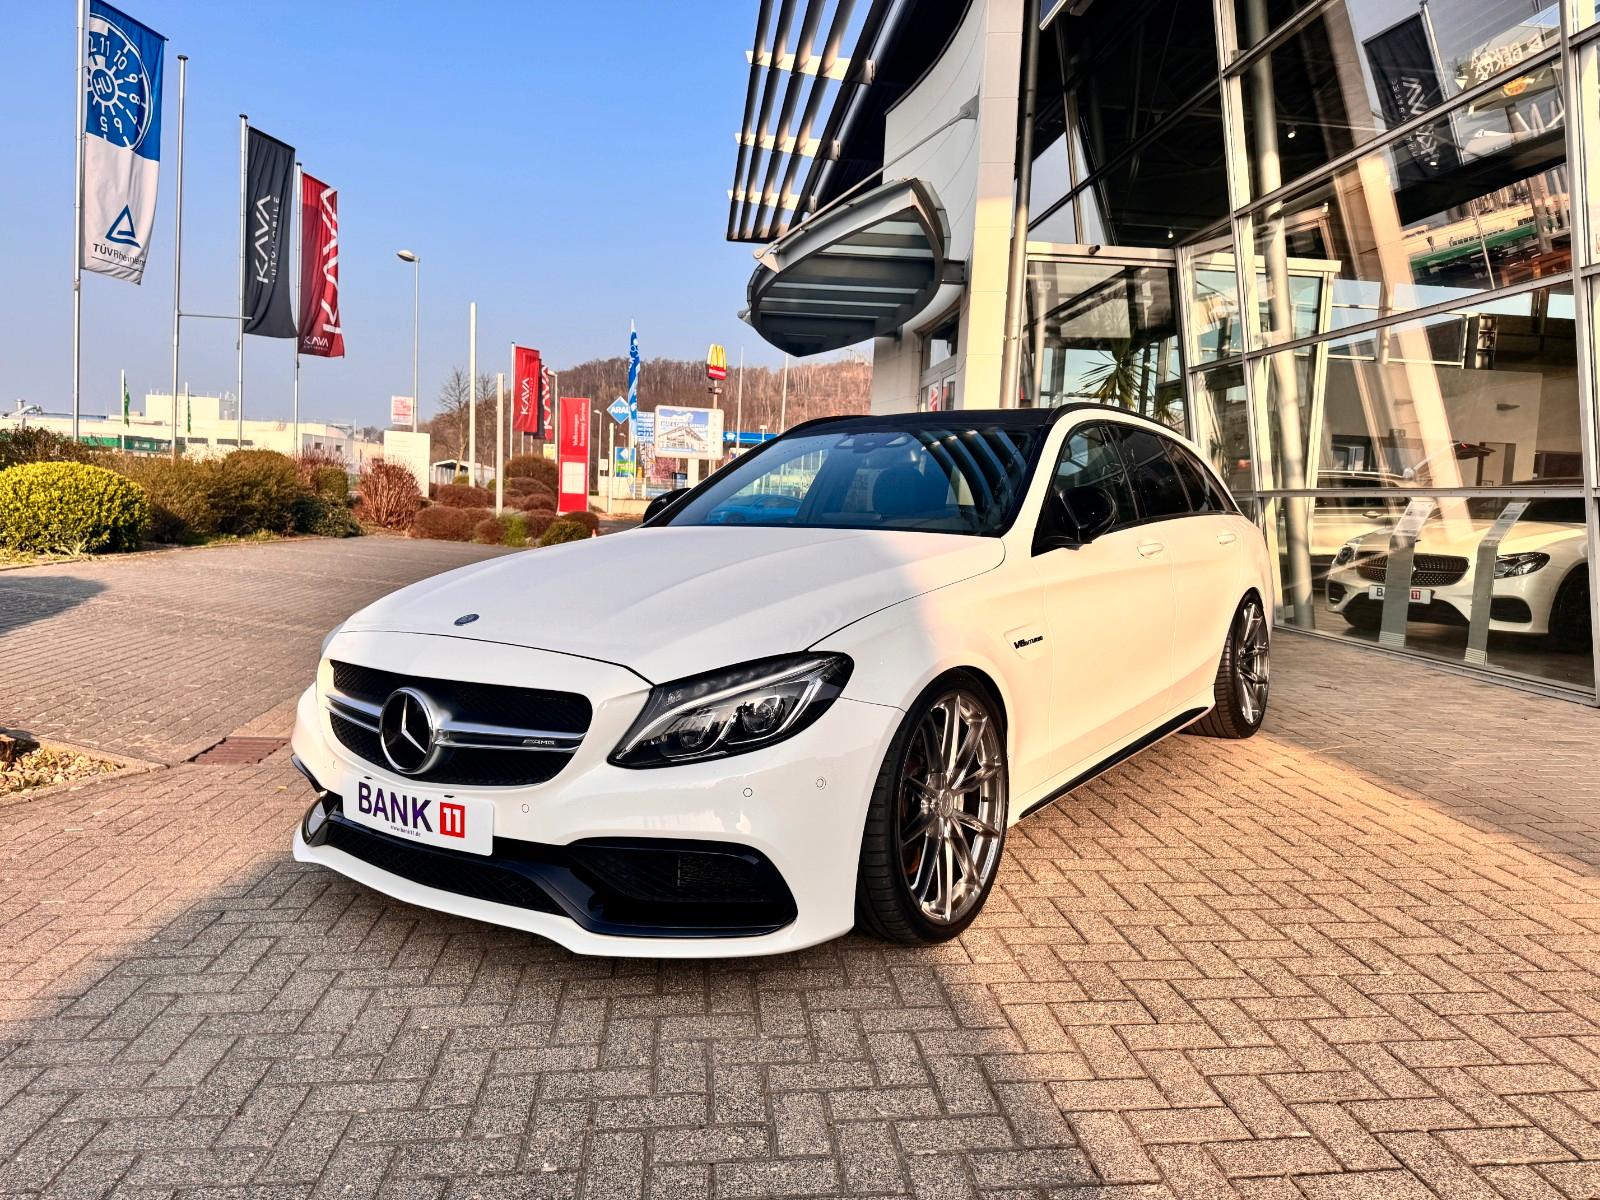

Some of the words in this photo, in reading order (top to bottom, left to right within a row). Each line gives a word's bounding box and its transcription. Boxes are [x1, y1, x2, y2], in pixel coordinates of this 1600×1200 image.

[100, 37, 110, 57] 11
[113, 49, 128, 71] 10
[94, 76, 113, 95] HU
[124, 73, 139, 84] 9
[128, 92, 141, 105] 8
[255, 194, 271, 284] KAVA
[319, 187, 343, 334] KAVA
[303, 335, 330, 348] KAVA
[520, 377, 531, 416] KAVA
[610, 405, 630, 414] ARAL
[358, 781, 433, 833] BANK
[442, 804, 463, 836] 11
